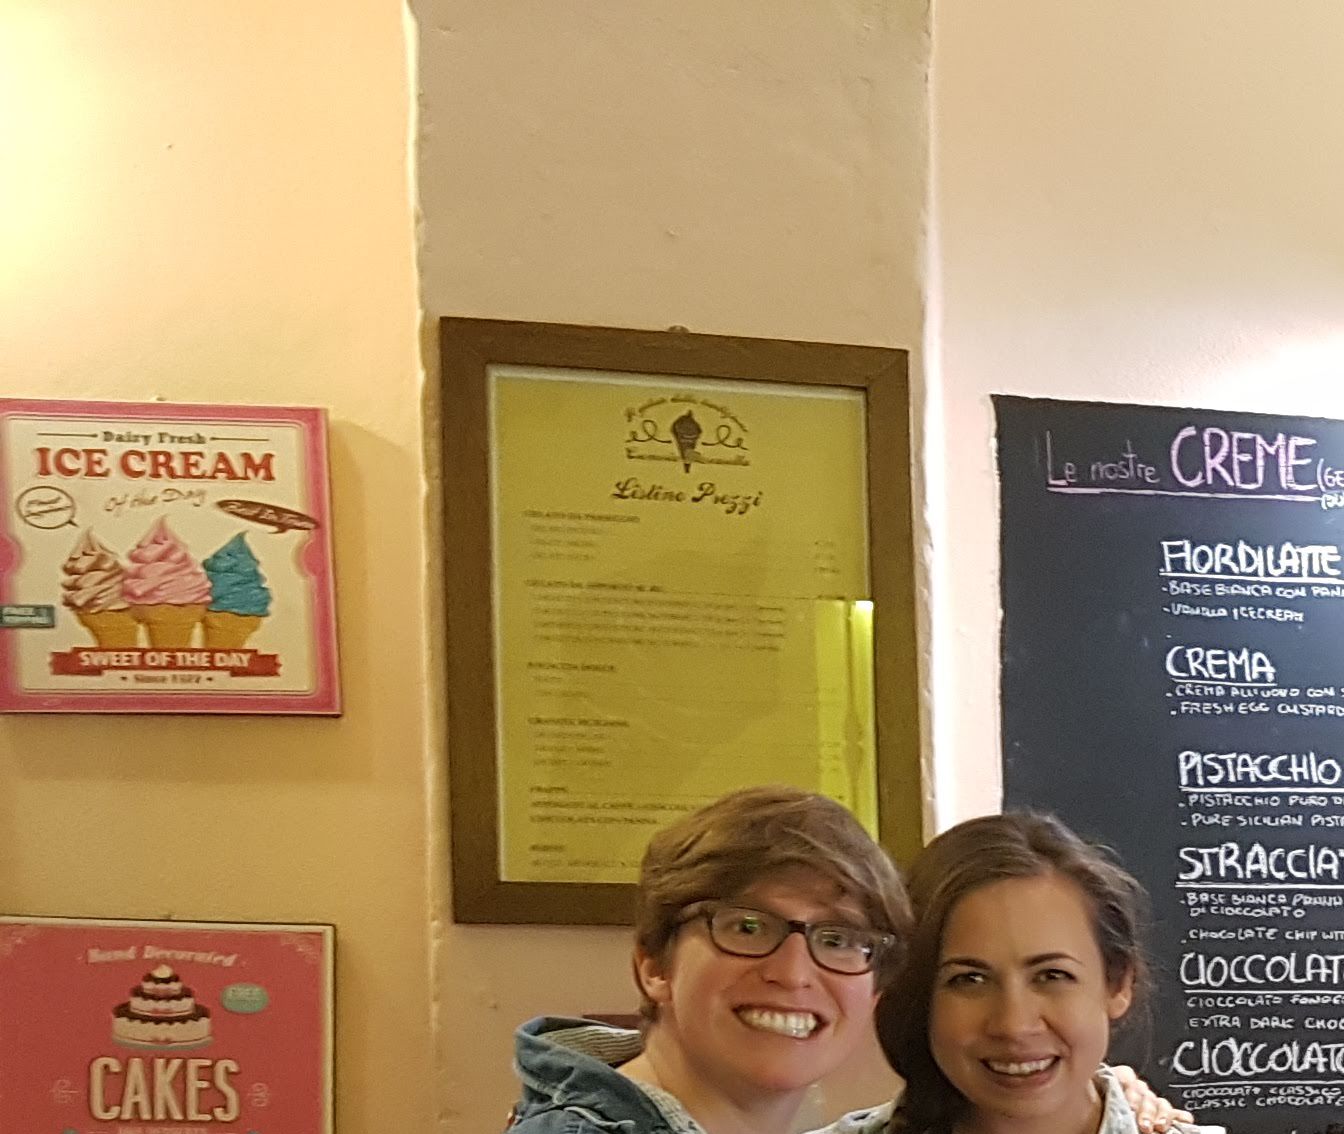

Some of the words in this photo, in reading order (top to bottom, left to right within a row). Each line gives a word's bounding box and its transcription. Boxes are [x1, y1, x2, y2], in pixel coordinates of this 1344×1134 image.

[36, 447, 111, 478] ICE
[120, 450, 276, 481] CREAM
[1046, 430, 1078, 486] Le
[1091, 440, 1160, 483] nostre
[1170, 426, 1317, 490] CREME
[1160, 539, 1342, 578] FIORDILATTE
[1169, 581, 1211, 596] BASE
[79, 651, 142, 667] SWEET
[145, 652, 174, 667] OF
[175, 652, 211, 667] THE
[214, 652, 251, 668] DAY
[1165, 645, 1277, 683] CREMA
[1175, 684, 1225, 697] CREMA
[1307, 687, 1335, 698] CON
[1180, 702, 1234, 715] FRESH
[1238, 702, 1270, 714] EGG
[1178, 750, 1342, 786] PISTACCHIO
[1188, 794, 1280, 807] PISTACCHIO
[1288, 795, 1328, 807] PURO
[1191, 814, 1230, 826] PURE
[1238, 814, 1303, 827] SICILIAN
[1186, 892, 1226, 905] BASE
[1231, 893, 1287, 905] BIANCA
[1210, 906, 1306, 918] CIOCCOLATO
[1189, 927, 1279, 941] CHOCOLATE
[1187, 994, 1282, 1007] CIOCCOLATO
[1189, 1015, 1241, 1030] EXTRA
[1250, 1016, 1295, 1030] DARK
[88, 1056, 241, 1122] CAKES
[1185, 1098, 1246, 1111] CLASSIC
